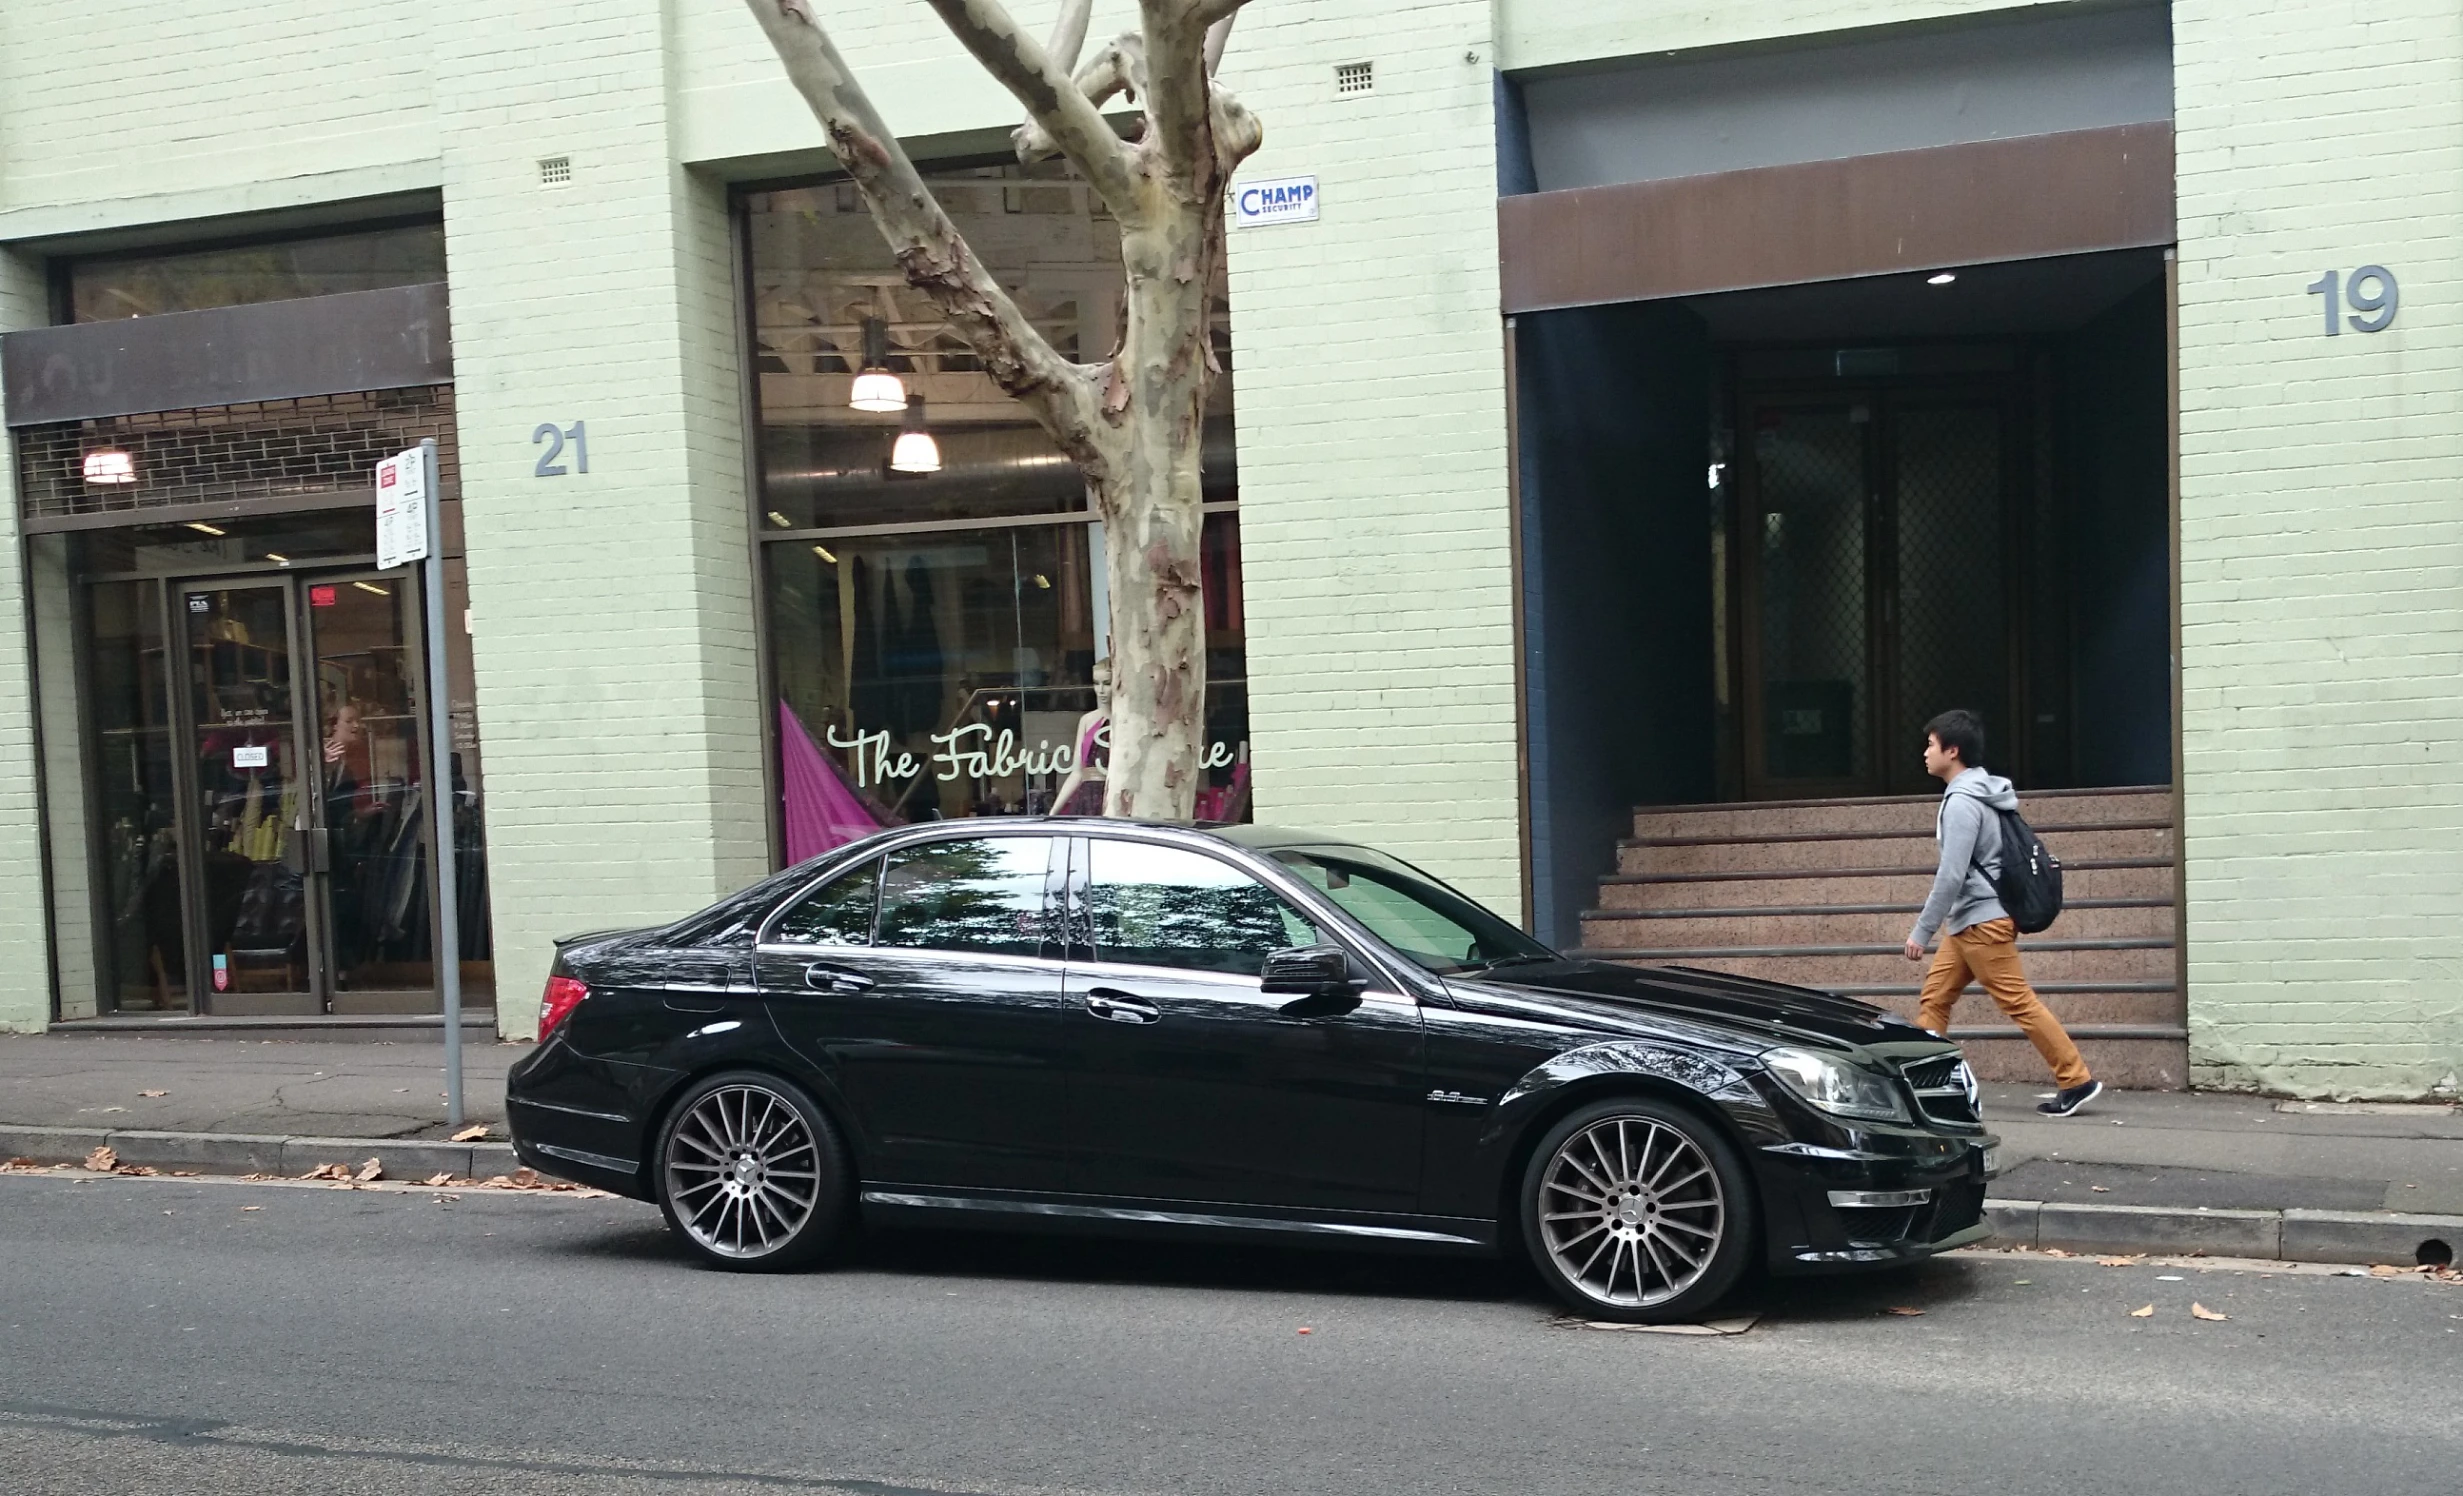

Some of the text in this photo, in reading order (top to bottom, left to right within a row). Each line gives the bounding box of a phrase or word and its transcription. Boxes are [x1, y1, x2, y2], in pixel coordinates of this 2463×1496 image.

[1240, 185, 1313, 216] CHAMP
[1262, 203, 1301, 213] SECURITY
[2307, 264, 2399, 337] 19
[532, 420, 588, 477] 21
[827, 724, 920, 788] The
[931, 723, 1074, 781] Fabric
